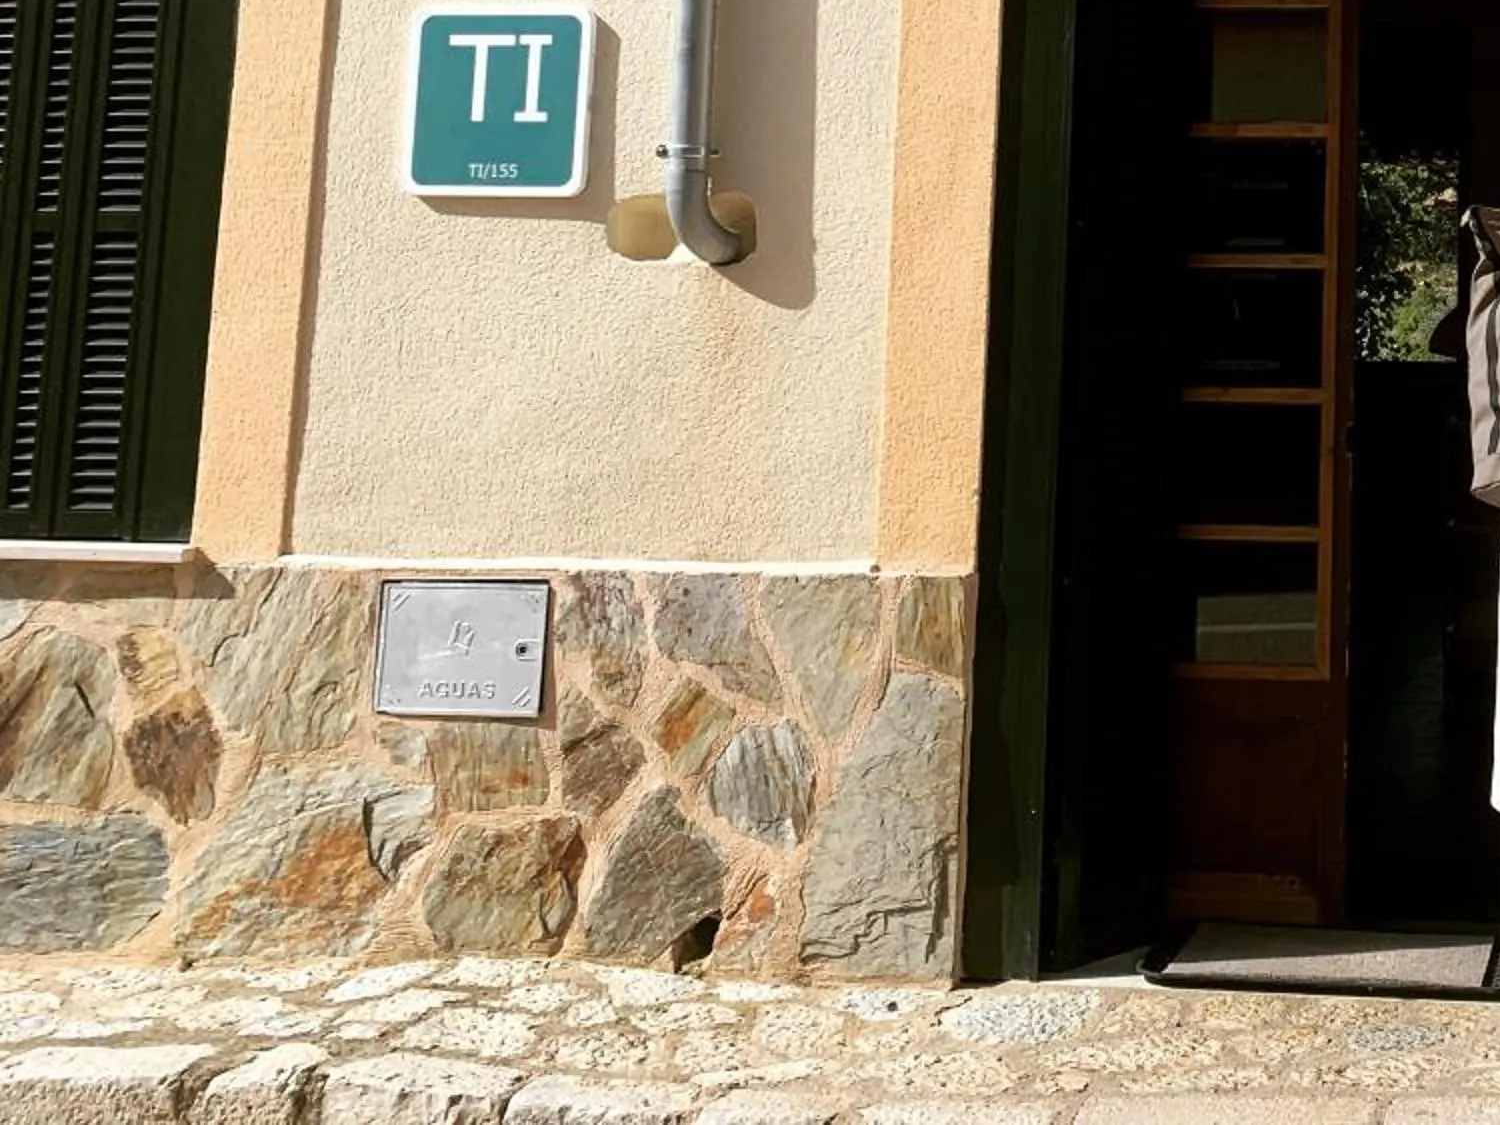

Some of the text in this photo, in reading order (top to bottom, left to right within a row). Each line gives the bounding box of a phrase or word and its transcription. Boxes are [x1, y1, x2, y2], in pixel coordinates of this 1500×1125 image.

[449, 34, 553, 122] TI
[468, 163, 519, 180] TI/155
[416, 680, 498, 700] AGUAS
